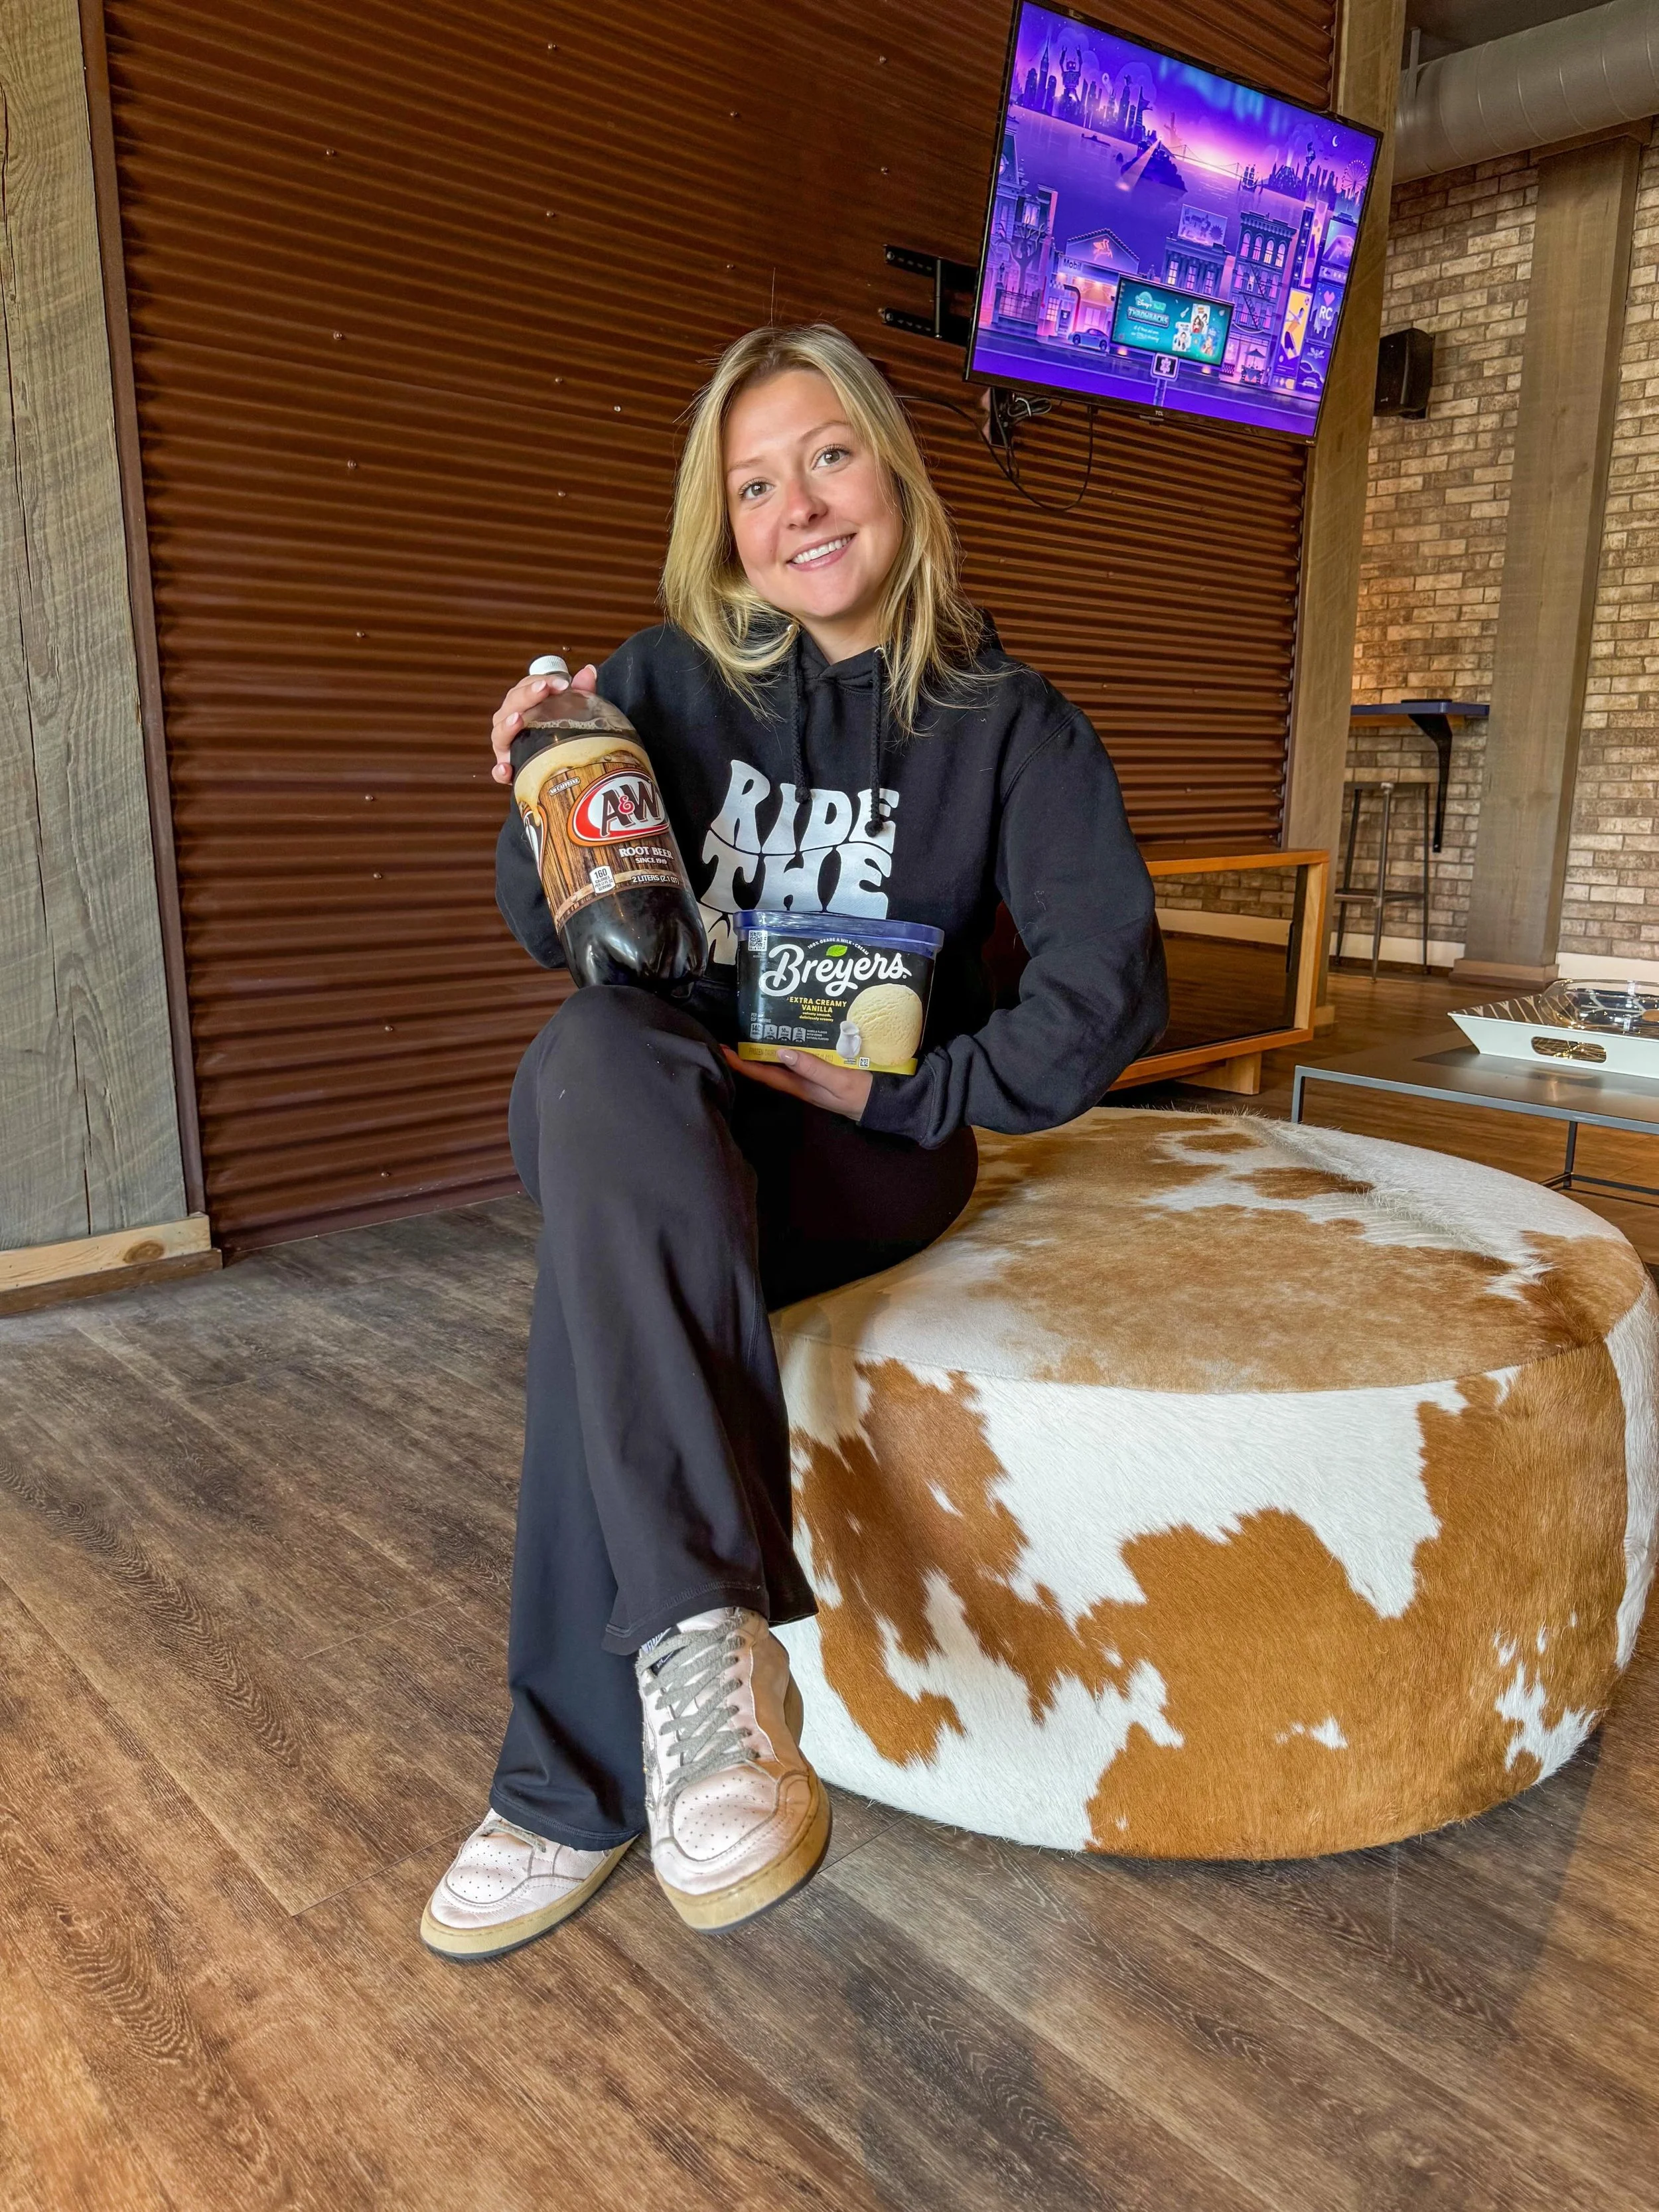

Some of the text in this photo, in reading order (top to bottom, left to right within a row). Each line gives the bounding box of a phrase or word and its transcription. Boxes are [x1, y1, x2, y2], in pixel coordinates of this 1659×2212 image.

[1064, 258, 1082, 271] Mobil
[1319, 305, 1333, 321] RC
[600, 779, 662, 838] A&W
[711, 759, 899, 854] RIDE
[618, 846, 674, 860] ROOT BEER
[594, 868, 608, 879] 160
[595, 875, 611, 884] CALORIES
[637, 874, 660, 883] LITERS
[700, 829, 892, 921] THE
[807, 941, 820, 950] 100%
[758, 943, 912, 997] Breyers
[789, 996, 847, 1007] EXTRA CREAMY
[802, 1004, 833, 1013] VANILLA
